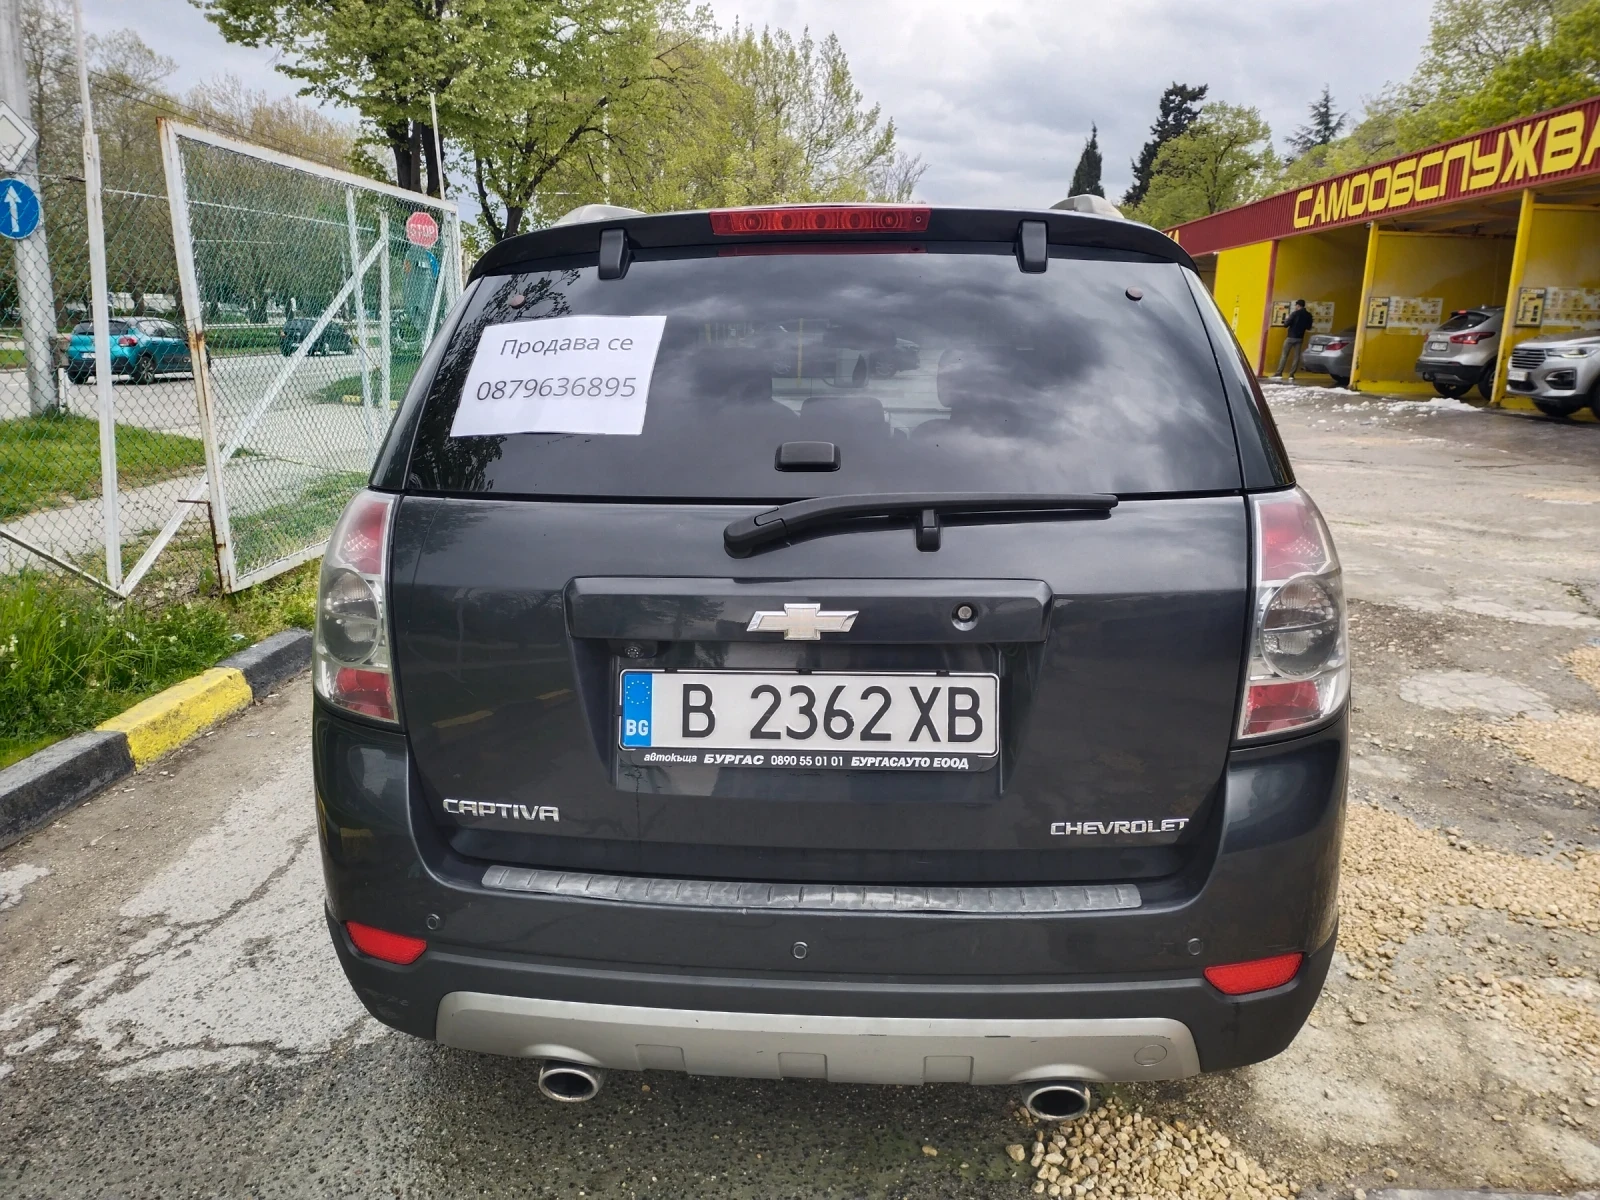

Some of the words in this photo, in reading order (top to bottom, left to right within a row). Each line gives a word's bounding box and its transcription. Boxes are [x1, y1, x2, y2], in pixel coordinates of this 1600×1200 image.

[410, 223, 435, 238] STOP
[500, 337, 600, 358] Продава
[607, 337, 634, 351] се
[476, 377, 636, 401] 0879636895
[682, 683, 716, 738] B
[750, 684, 892, 741] 2362
[908, 686, 983, 742] XB
[625, 719, 649, 736] BG
[643, 752, 697, 764] автокъща
[703, 754, 765, 765] БУРГАС
[770, 755, 797, 766] 0890
[799, 756, 812, 766] 55
[815, 756, 828, 766] 01
[831, 756, 843, 766] 01
[851, 756, 930, 768] БУРГАСАУТО
[933, 757, 969, 769] ЕООД
[443, 798, 560, 822] CAPTIVA
[1050, 818, 1190, 835] CHEVROLET
